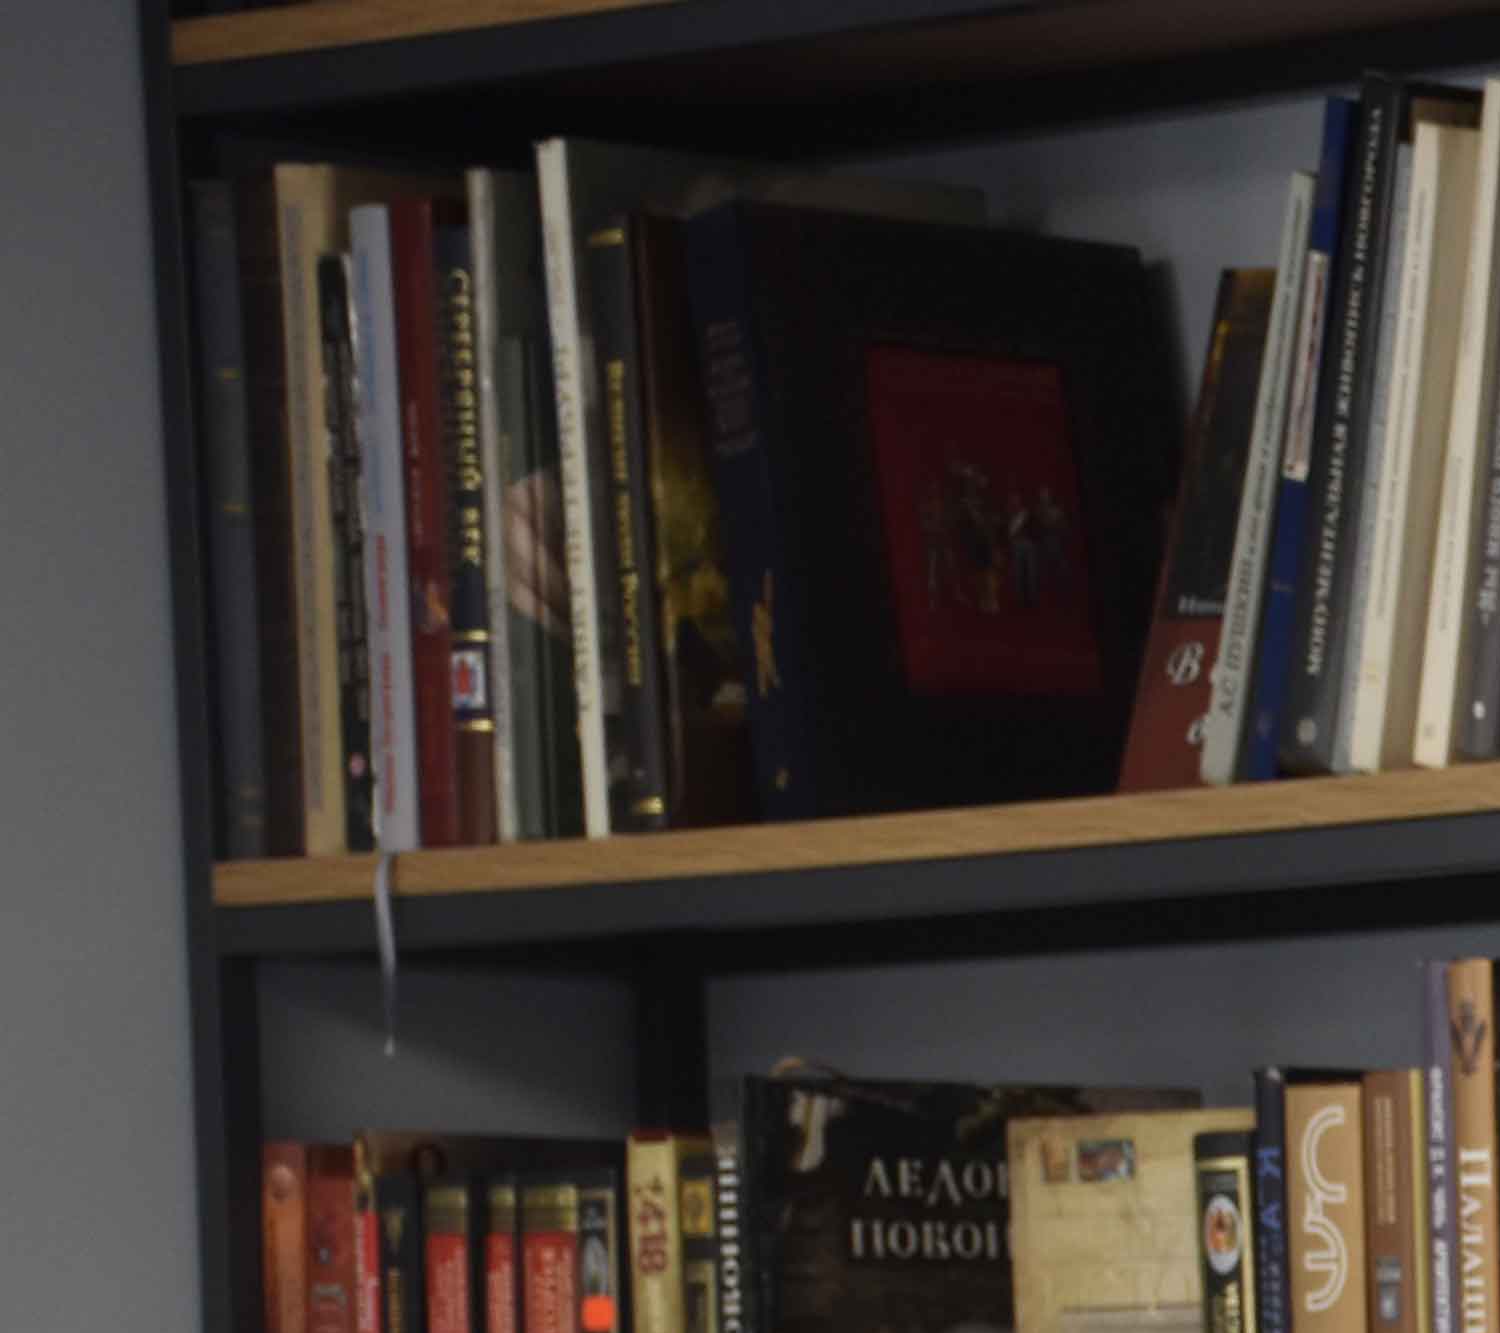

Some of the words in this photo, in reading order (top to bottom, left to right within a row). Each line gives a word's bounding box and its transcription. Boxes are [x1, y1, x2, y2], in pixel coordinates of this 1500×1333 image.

[1350, 106, 1384, 262] НОВГОРОДА
[1334, 262, 1367, 420] ЖИВОПИСЬ
[1304, 420, 1350, 678] МОНУМЕНТАЛЬНАЯ
